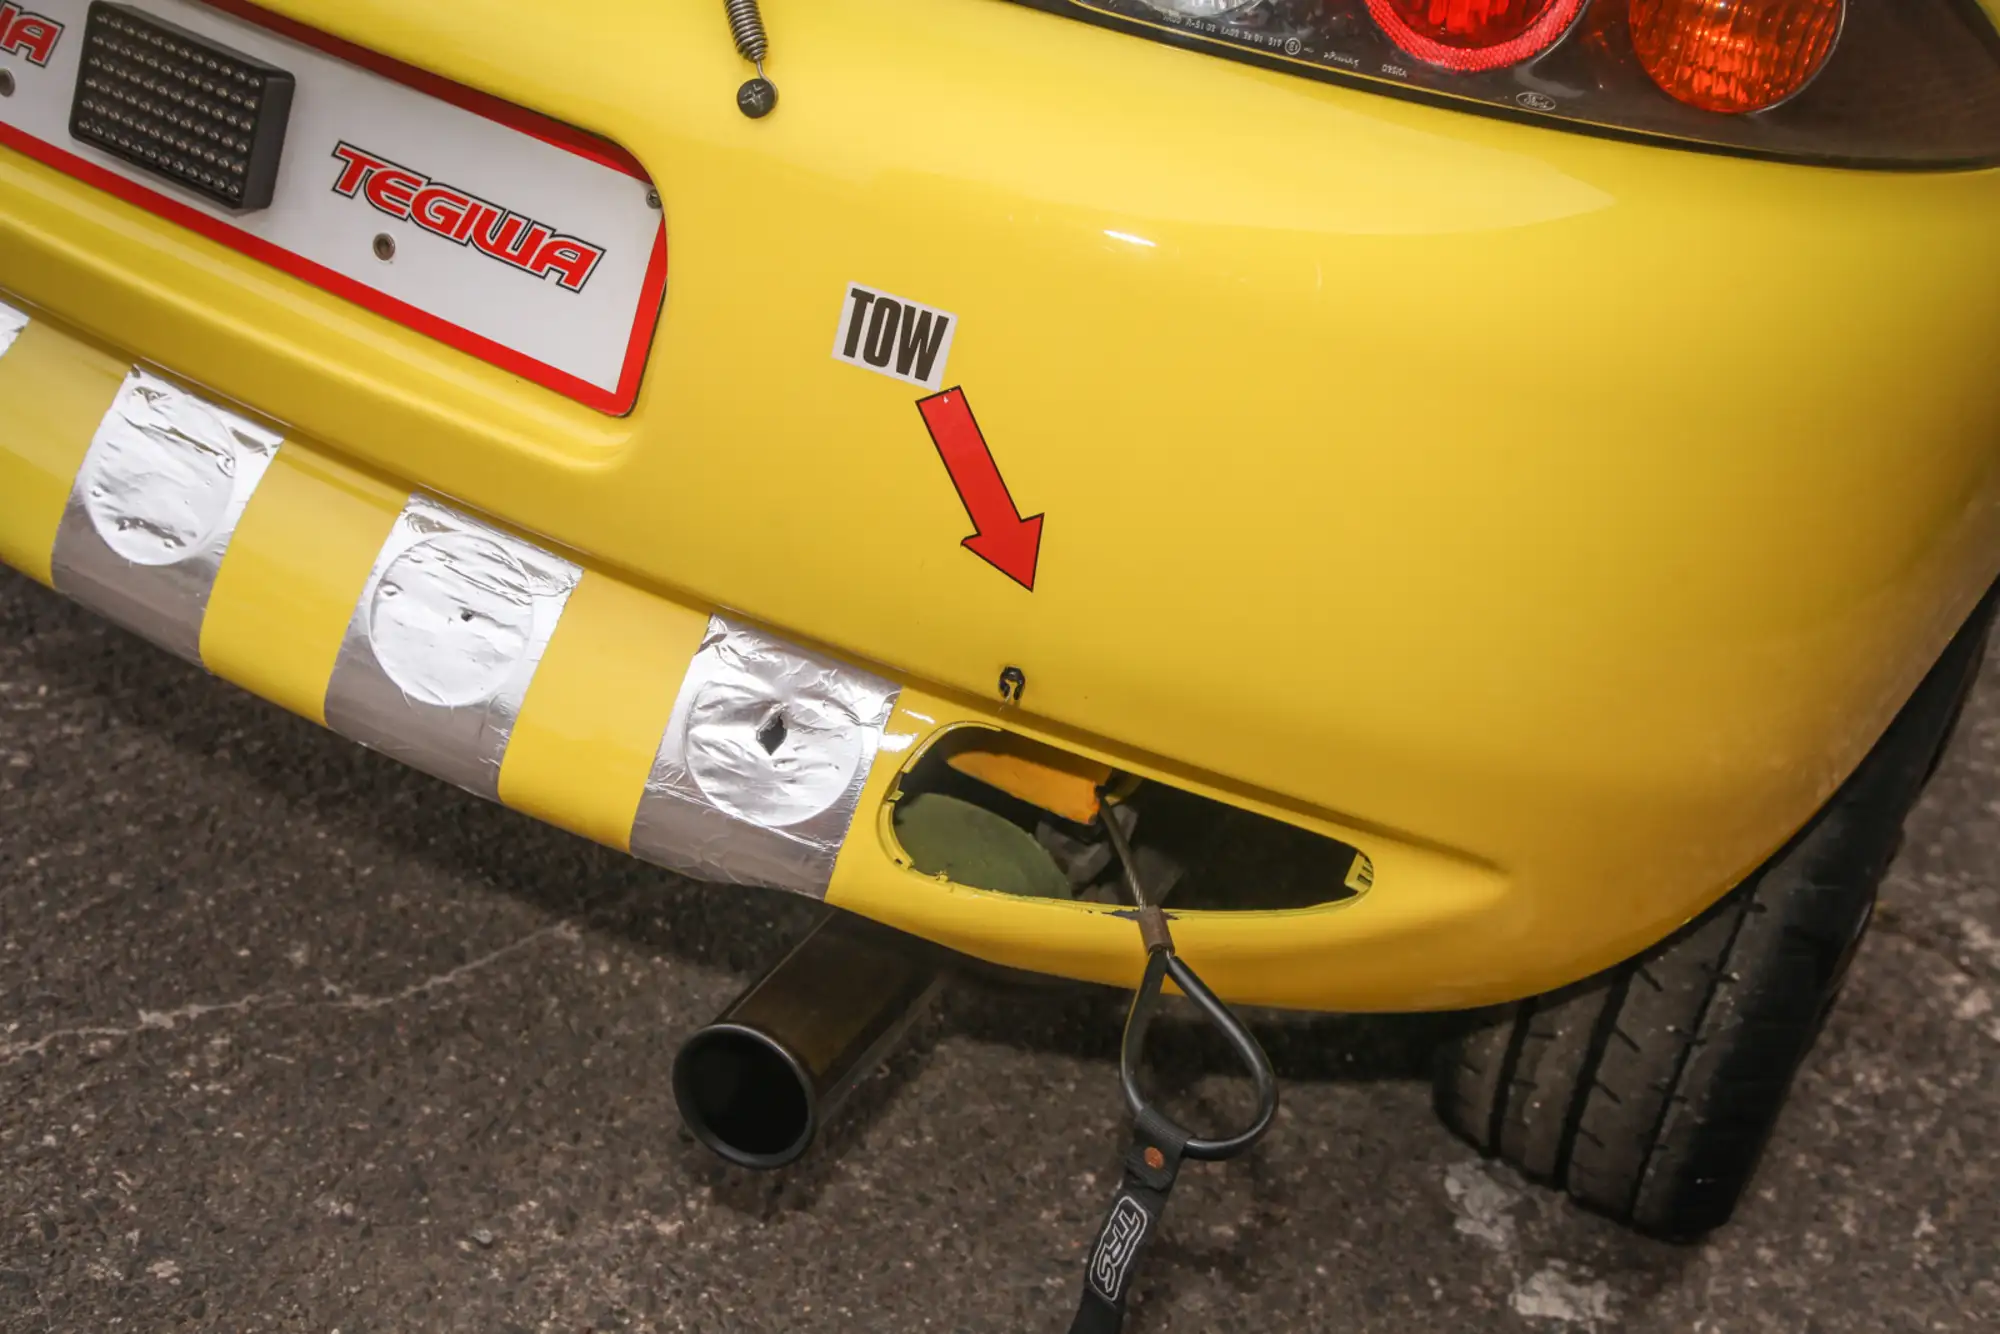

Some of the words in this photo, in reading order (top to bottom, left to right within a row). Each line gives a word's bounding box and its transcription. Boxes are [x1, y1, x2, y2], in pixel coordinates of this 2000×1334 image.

[332, 140, 605, 293] TEGIWA
[843, 287, 950, 382] TOW
[1097, 1209, 1141, 1292] TRS
